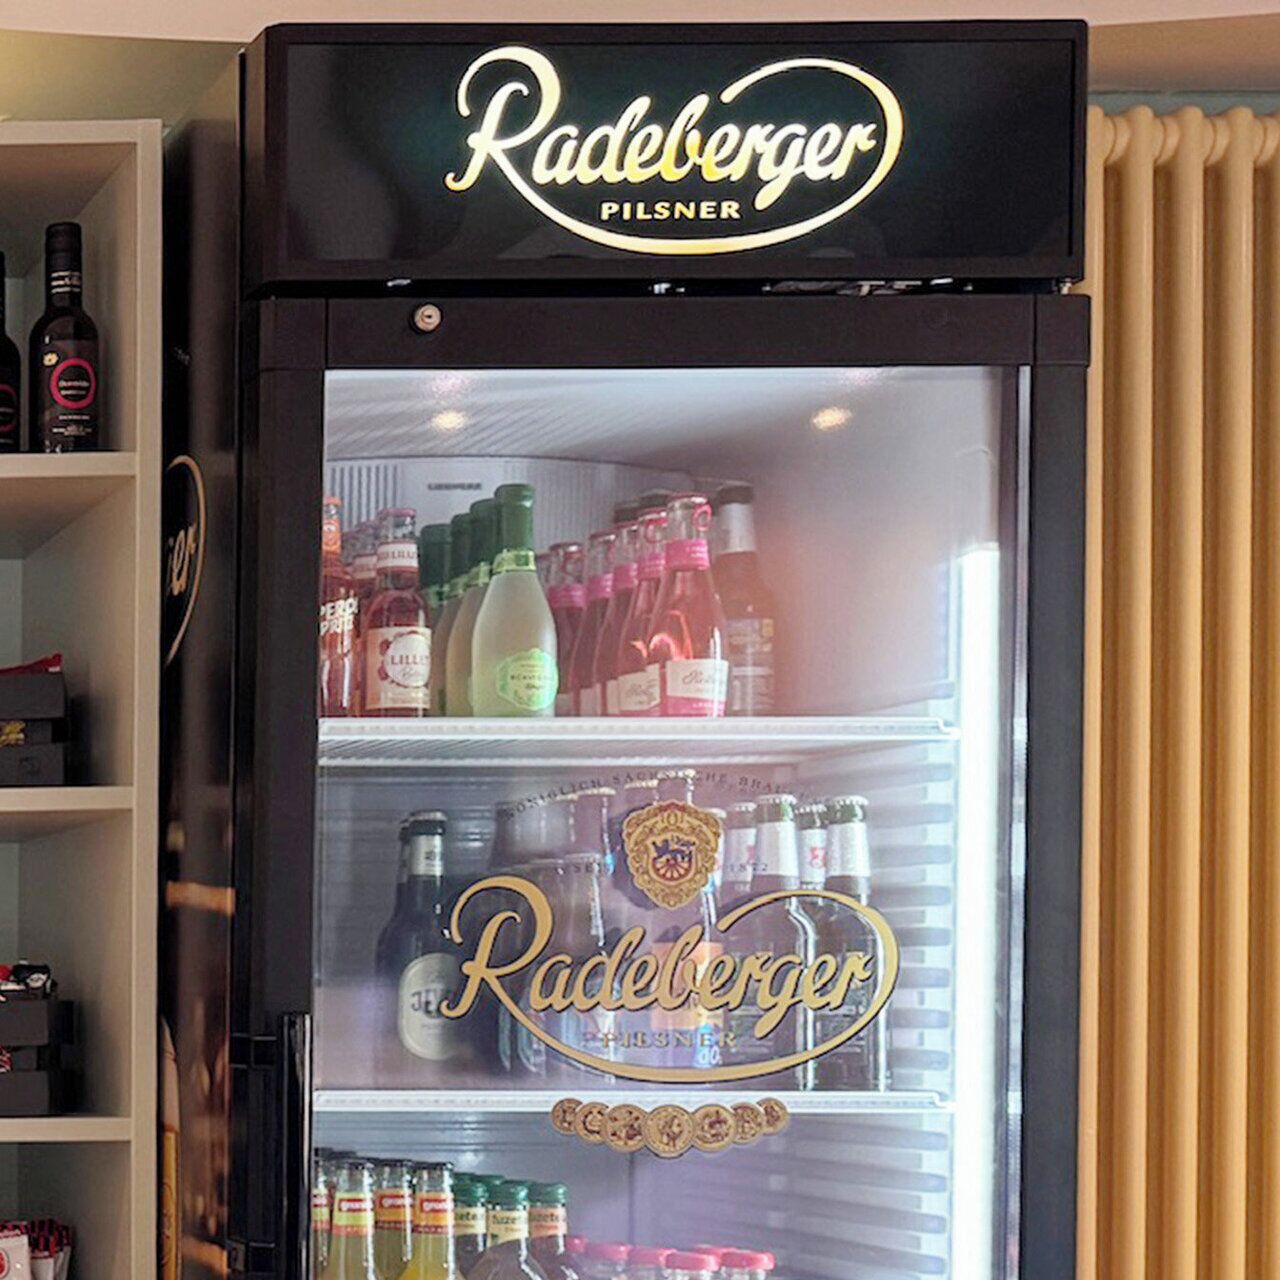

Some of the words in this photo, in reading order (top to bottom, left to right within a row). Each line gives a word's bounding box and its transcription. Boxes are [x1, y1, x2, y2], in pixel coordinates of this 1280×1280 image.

[444, 46, 880, 212] Radeberger
[600, 201, 742, 221] PILSNER
[441, 874, 875, 1038] Radeberger
[601, 1031, 737, 1048] PILSNER
